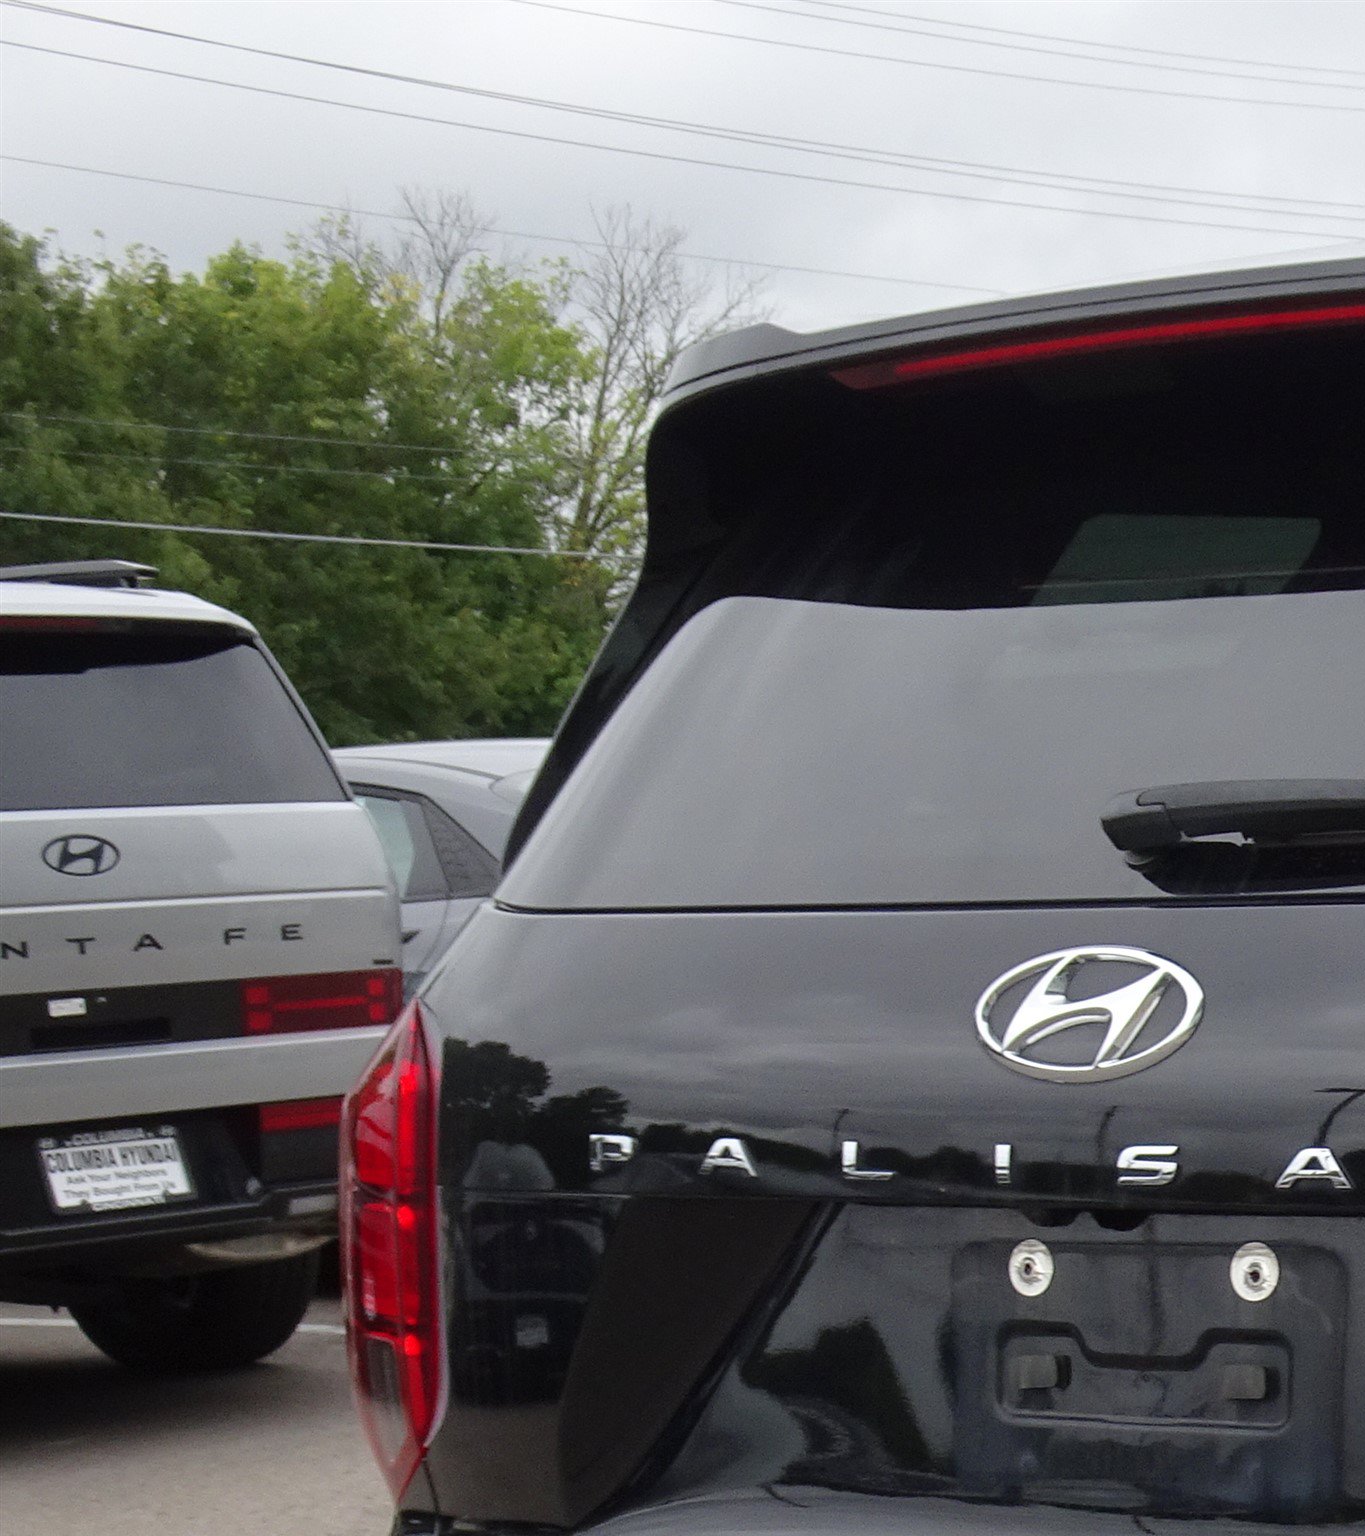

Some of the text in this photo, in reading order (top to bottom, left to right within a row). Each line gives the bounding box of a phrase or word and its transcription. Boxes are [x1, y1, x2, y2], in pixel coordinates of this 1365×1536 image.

[223, 923, 304, 946] FE
[45, 1143, 179, 1173] COLUMBIA HYUNDAI
